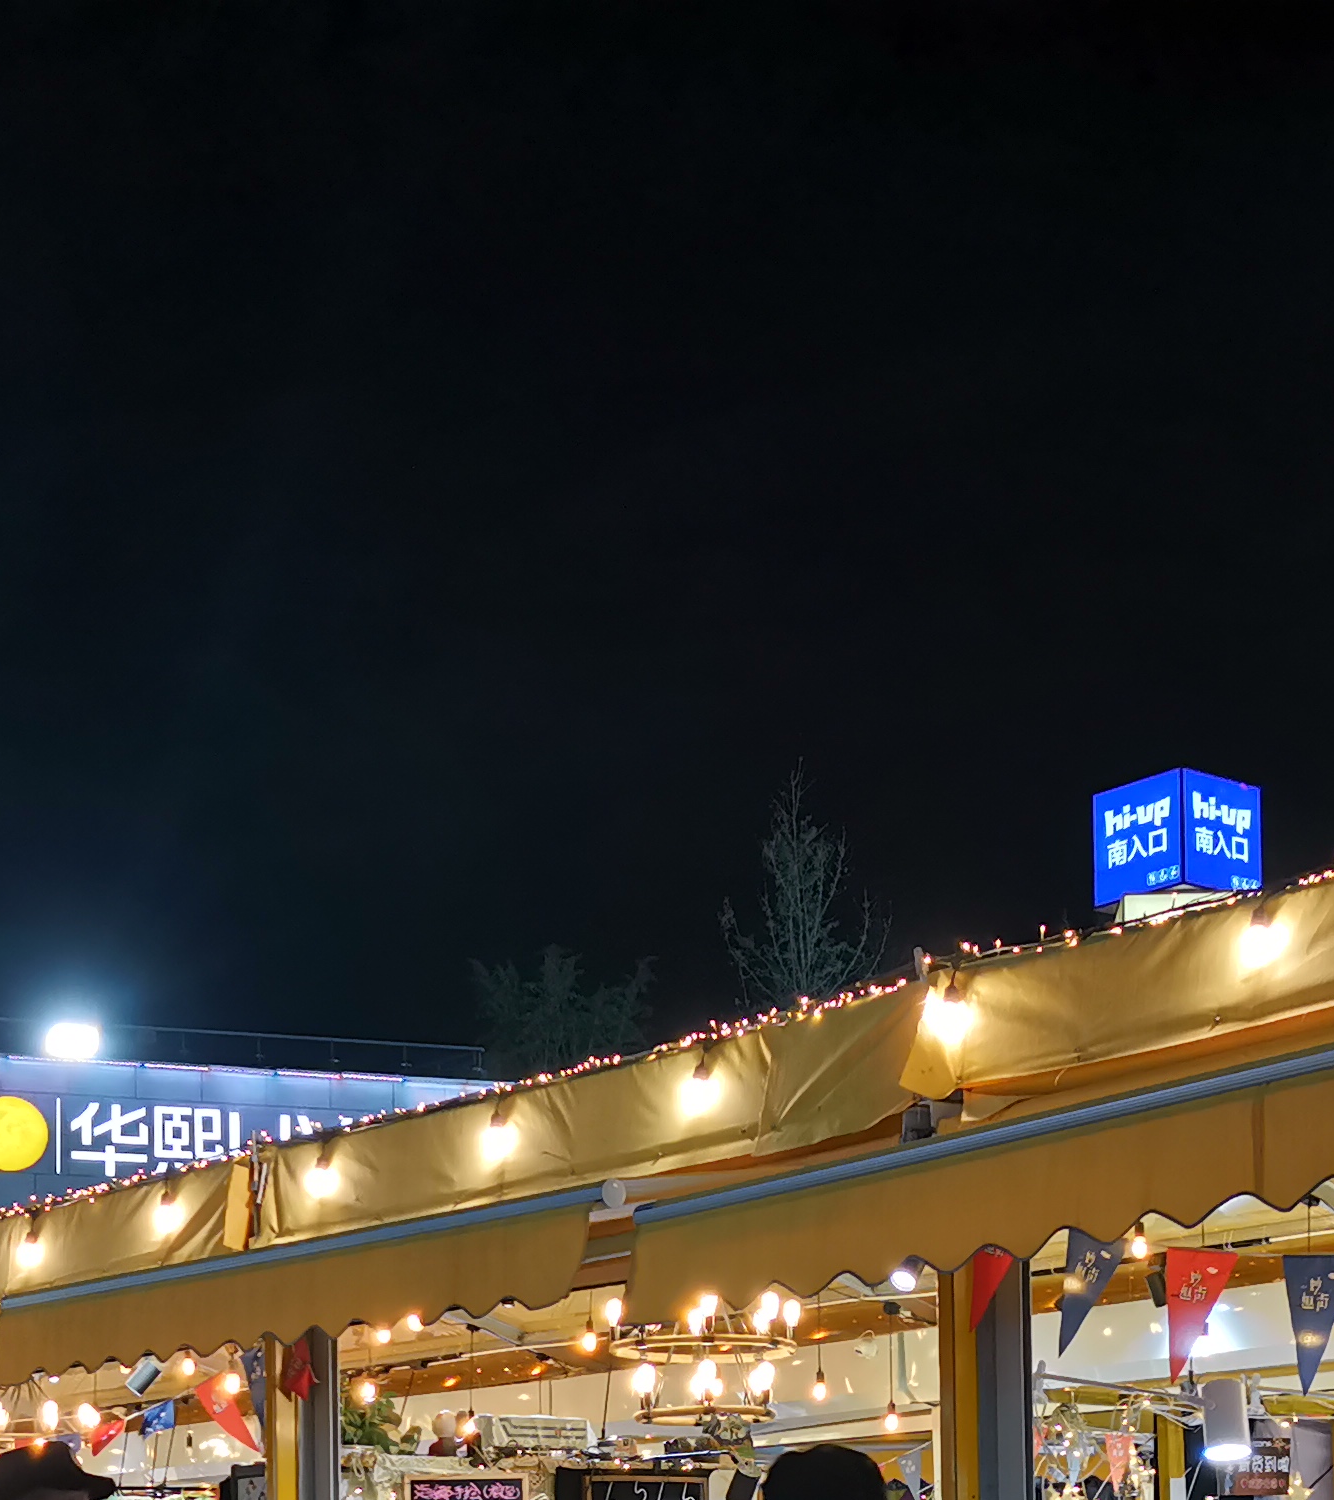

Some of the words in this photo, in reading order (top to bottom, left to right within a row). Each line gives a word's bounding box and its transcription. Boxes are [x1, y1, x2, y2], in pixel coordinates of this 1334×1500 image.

[1104, 796, 1171, 838] hi-up
[1192, 791, 1251, 835] hi-up
[1107, 828, 1168, 869] 南入口
[1195, 827, 1249, 863] 南入口
